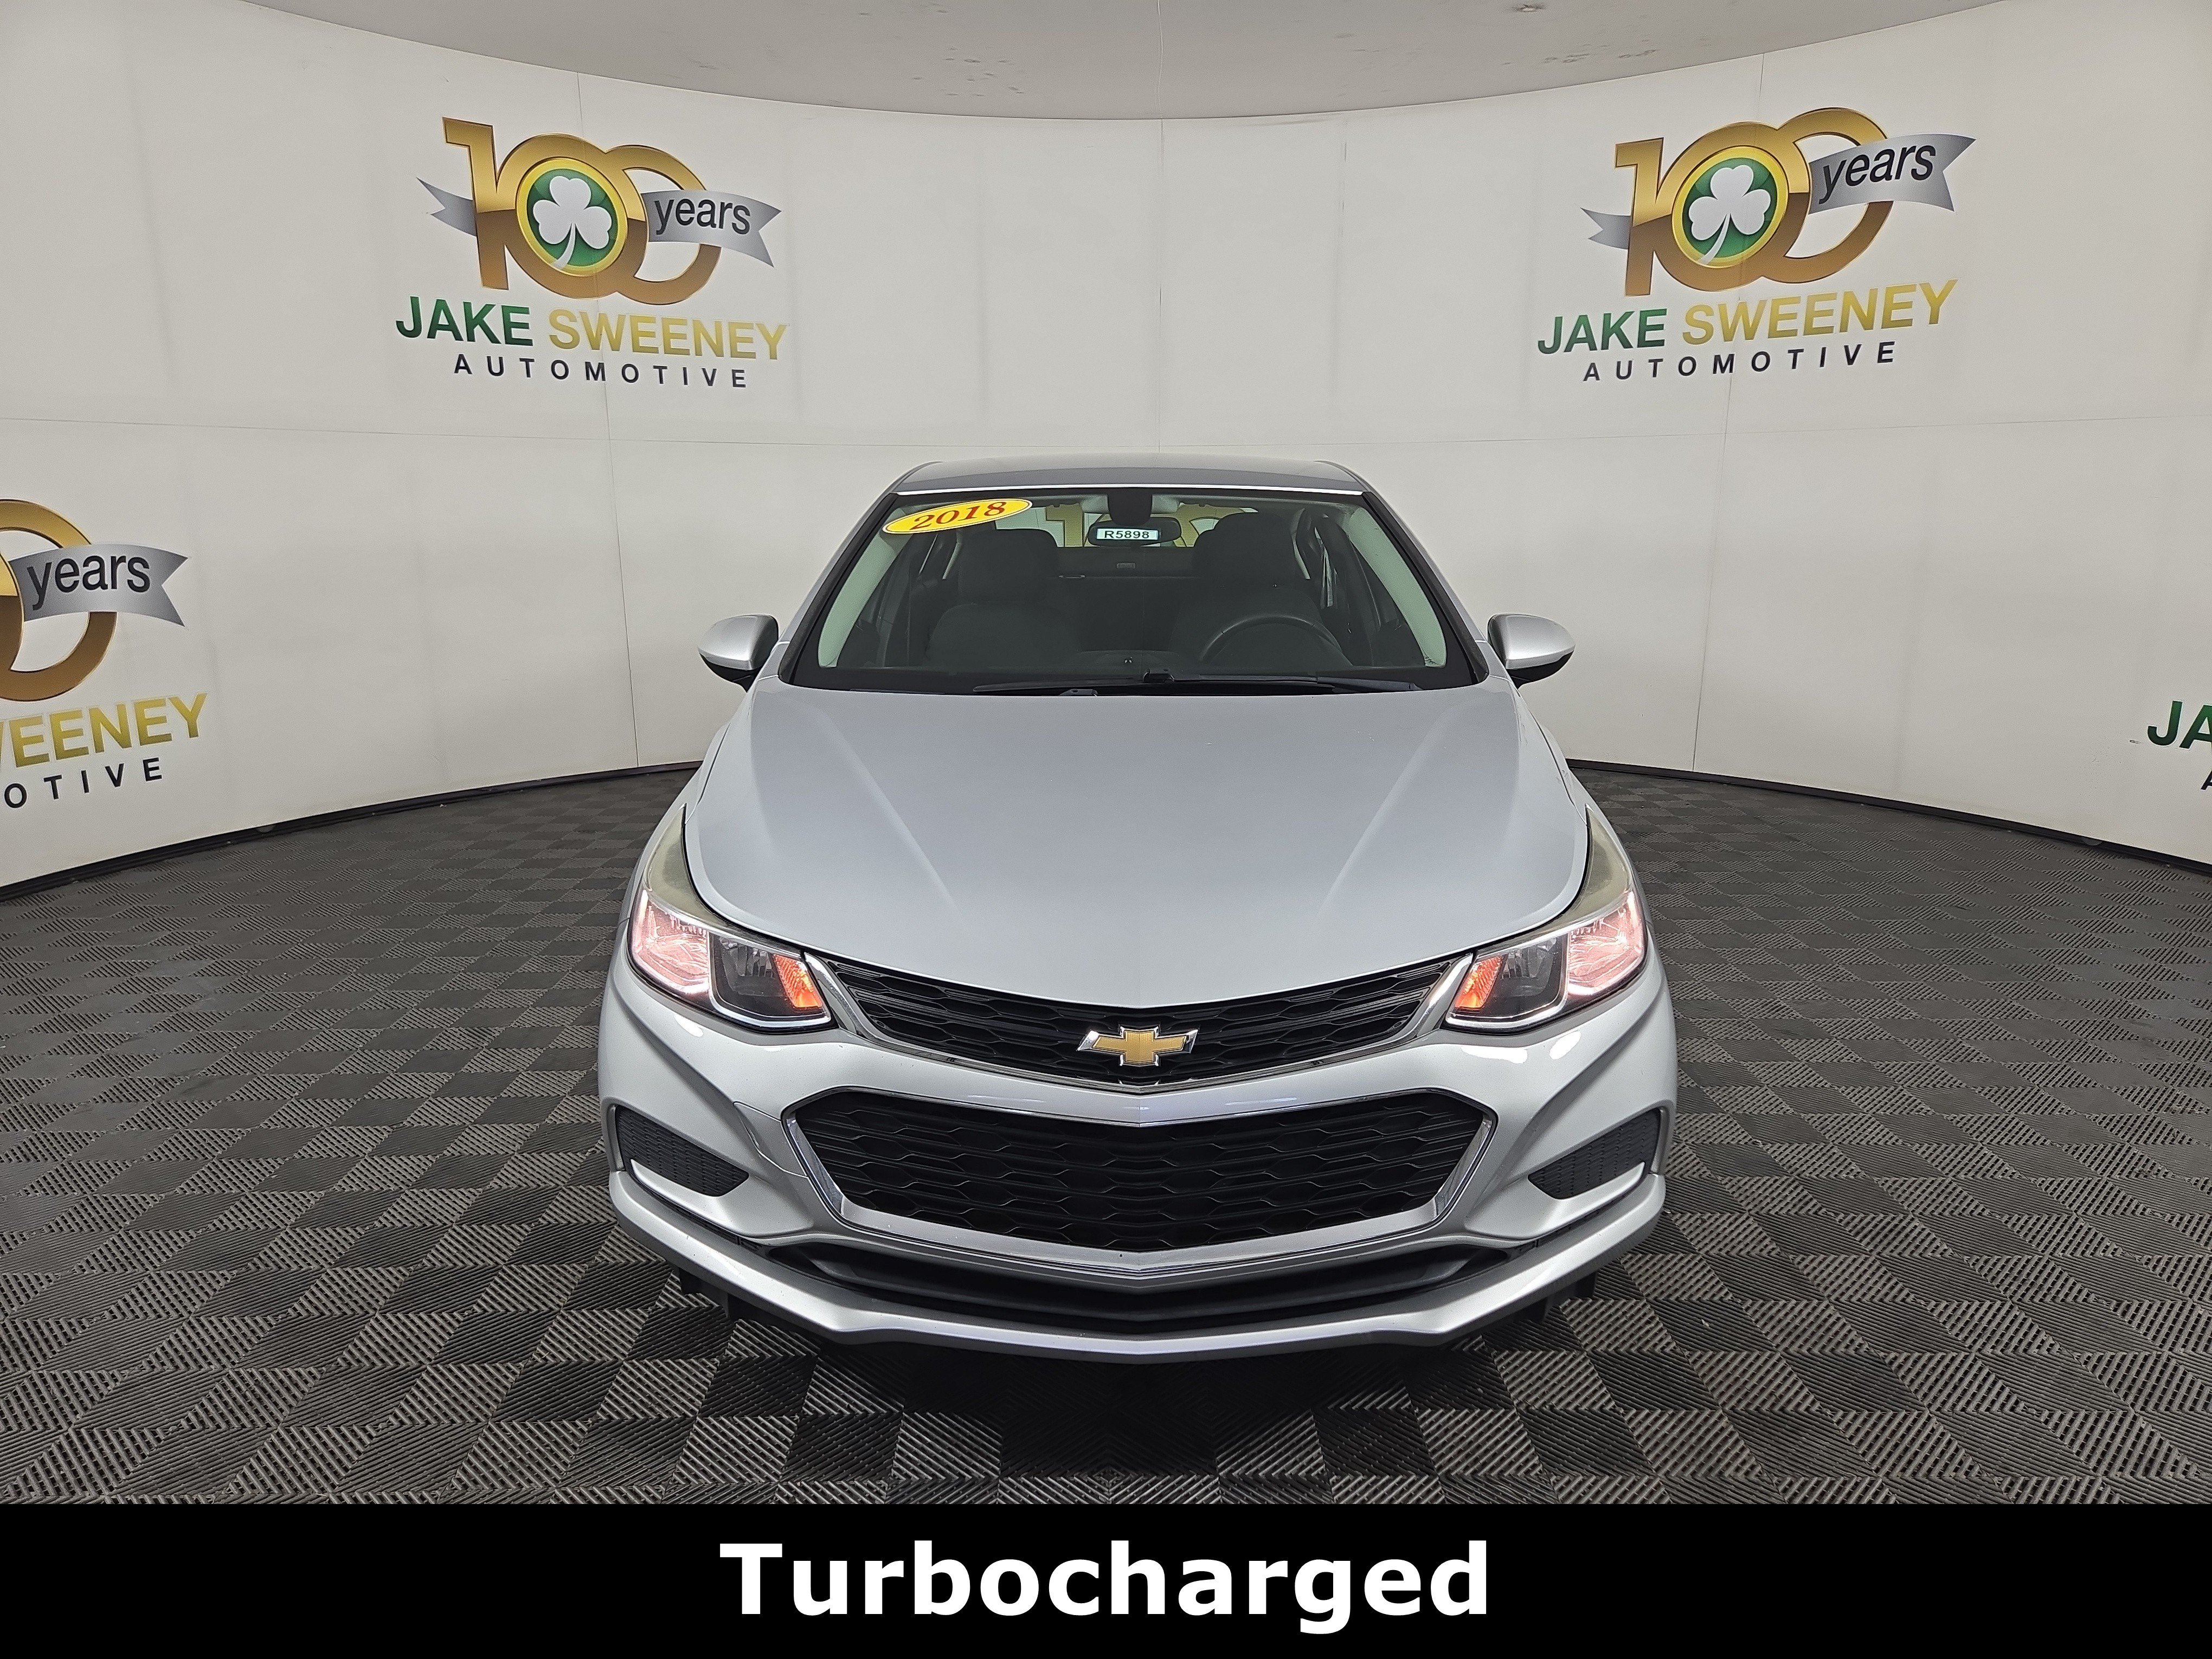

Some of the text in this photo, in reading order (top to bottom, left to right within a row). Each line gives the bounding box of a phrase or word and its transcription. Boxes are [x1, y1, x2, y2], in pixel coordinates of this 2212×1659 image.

[442, 117, 751, 305] 100 years
[1615, 107, 1937, 297] 100 years
[395, 295, 788, 361] JAKE SWEENEY
[1538, 279, 1959, 355] JAKE SWEENEY
[454, 353, 747, 388] AUTOMOTIVE
[1583, 341, 1896, 382] AUTOMOTIVE
[909, 501, 1007, 530] 2018
[1104, 530, 1149, 539] R5898
[26, 554, 151, 610] years
[0, 692, 208, 768] EENEY
